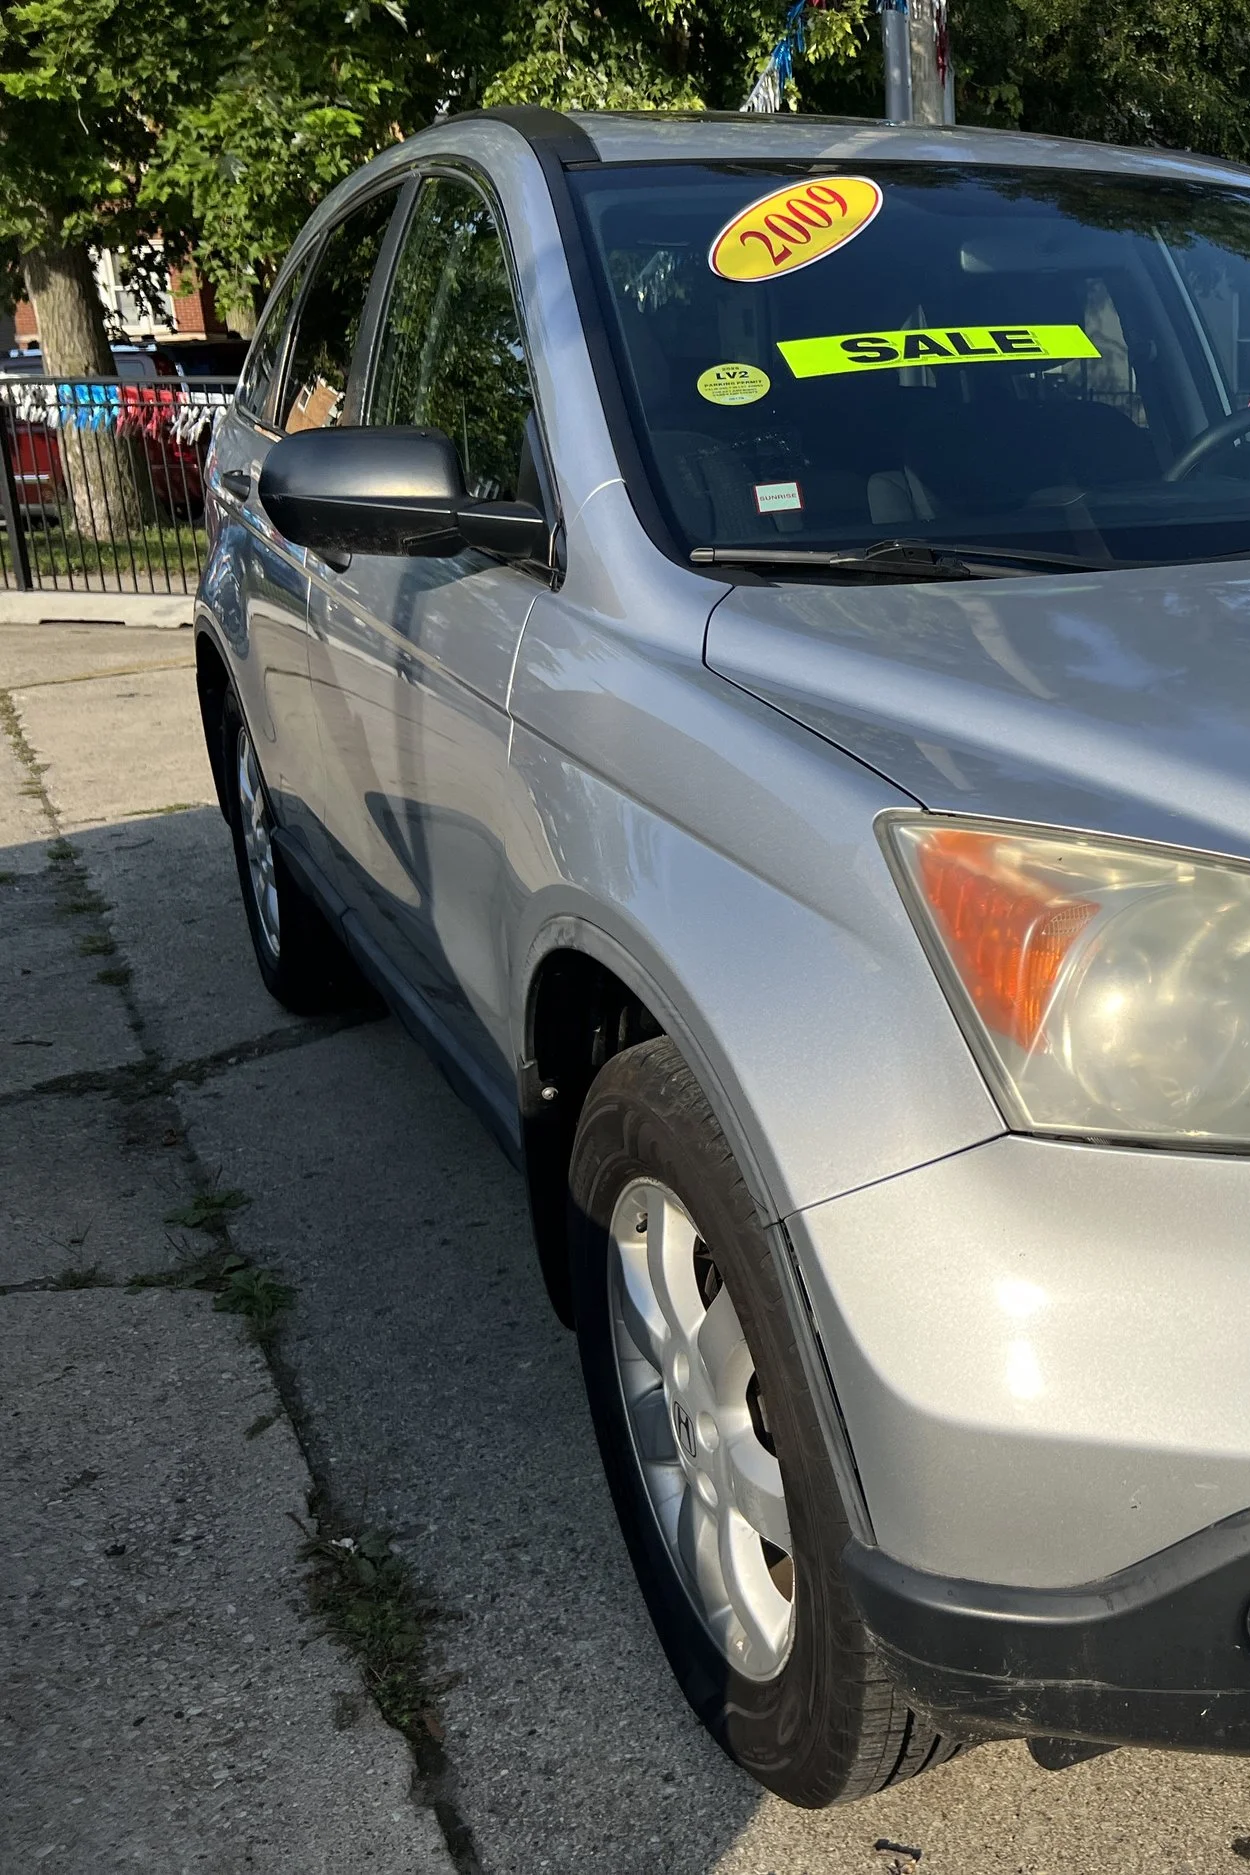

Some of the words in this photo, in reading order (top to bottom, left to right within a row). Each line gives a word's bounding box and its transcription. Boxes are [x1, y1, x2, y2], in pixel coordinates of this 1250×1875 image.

[740, 186, 848, 266] 2009
[839, 330, 1047, 364] SALE
[716, 371, 750, 380] LV2
[759, 493, 798, 502] SUNRISE
